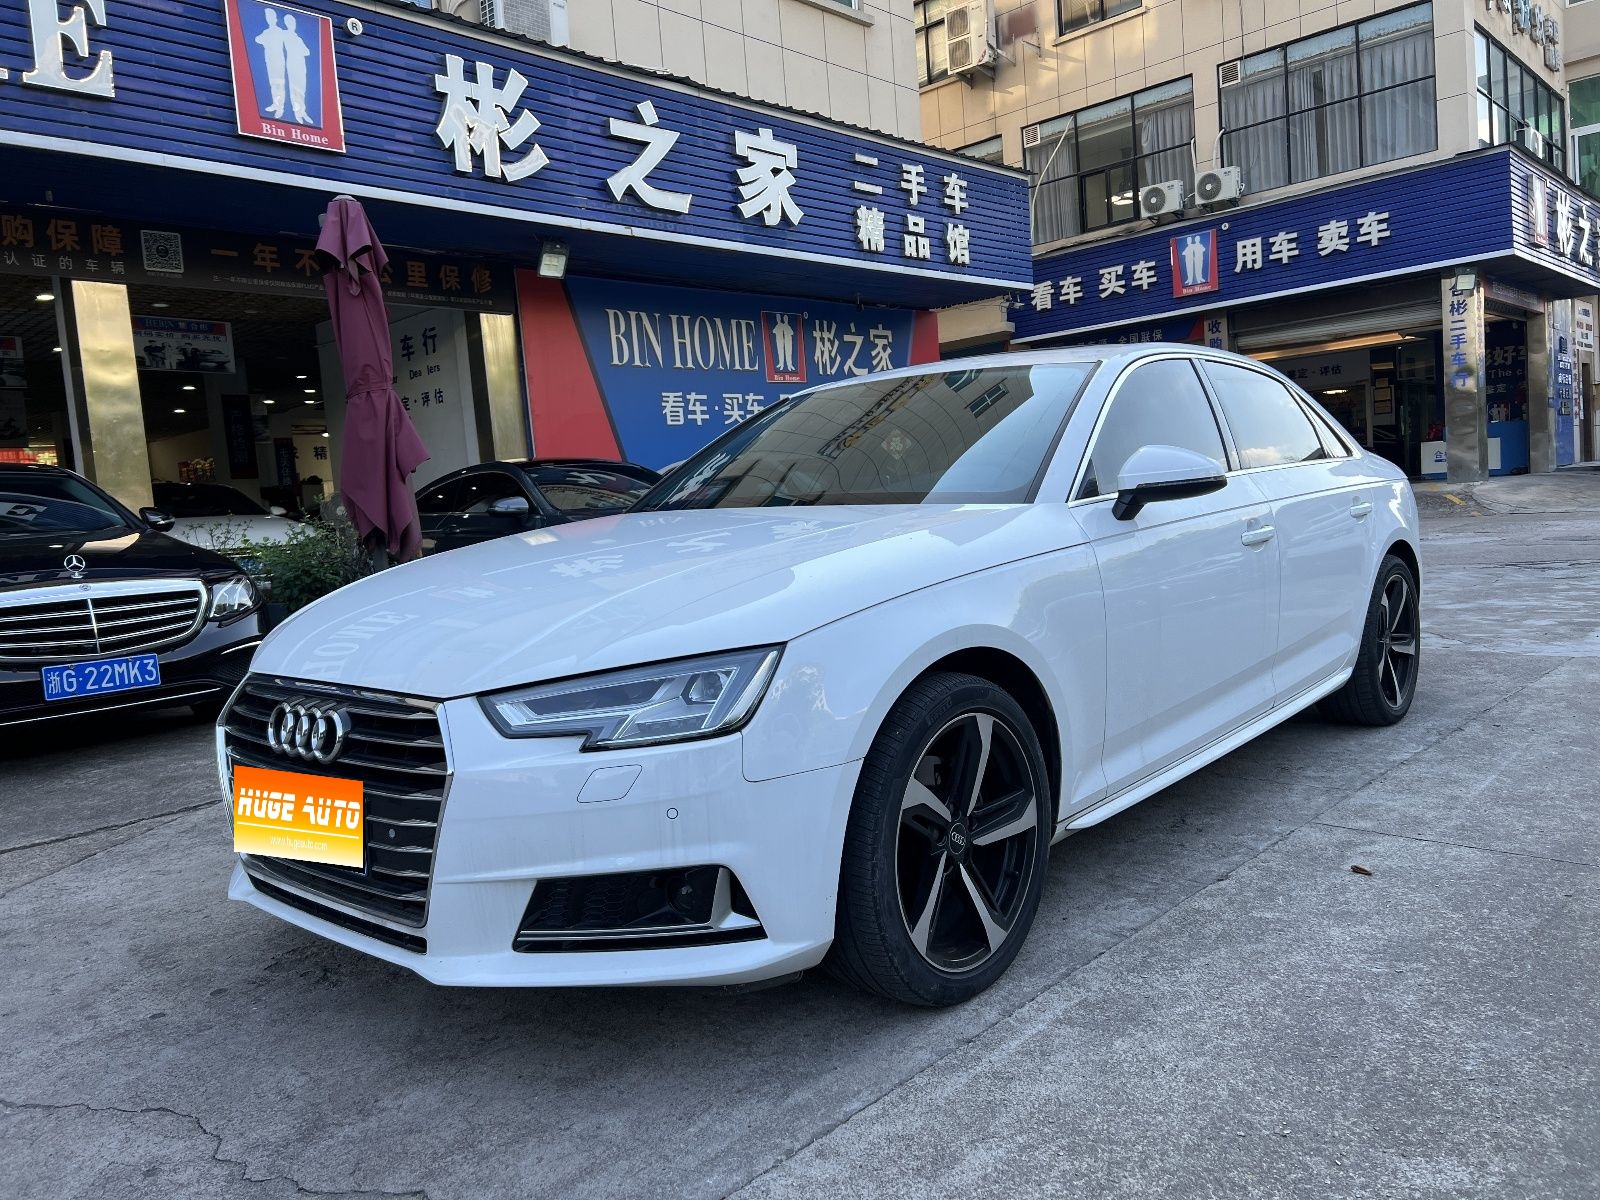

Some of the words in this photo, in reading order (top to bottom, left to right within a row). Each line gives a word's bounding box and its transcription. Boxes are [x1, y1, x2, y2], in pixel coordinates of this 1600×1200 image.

[261, 122, 286, 139] Bin
[291, 128, 329, 145] Home
[434, 53, 805, 228] 彬之家
[853, 152, 970, 216] 二手车
[856, 204, 971, 266] 精品馆
[1030, 275, 1083, 312] 看车
[1098, 260, 1158, 299] 买车
[1234, 231, 1299, 273] 用车
[1317, 211, 1392, 257] 卖车
[604, 308, 663, 370] BIN
[667, 312, 760, 373] HOME
[812, 318, 894, 377] 彬之家
